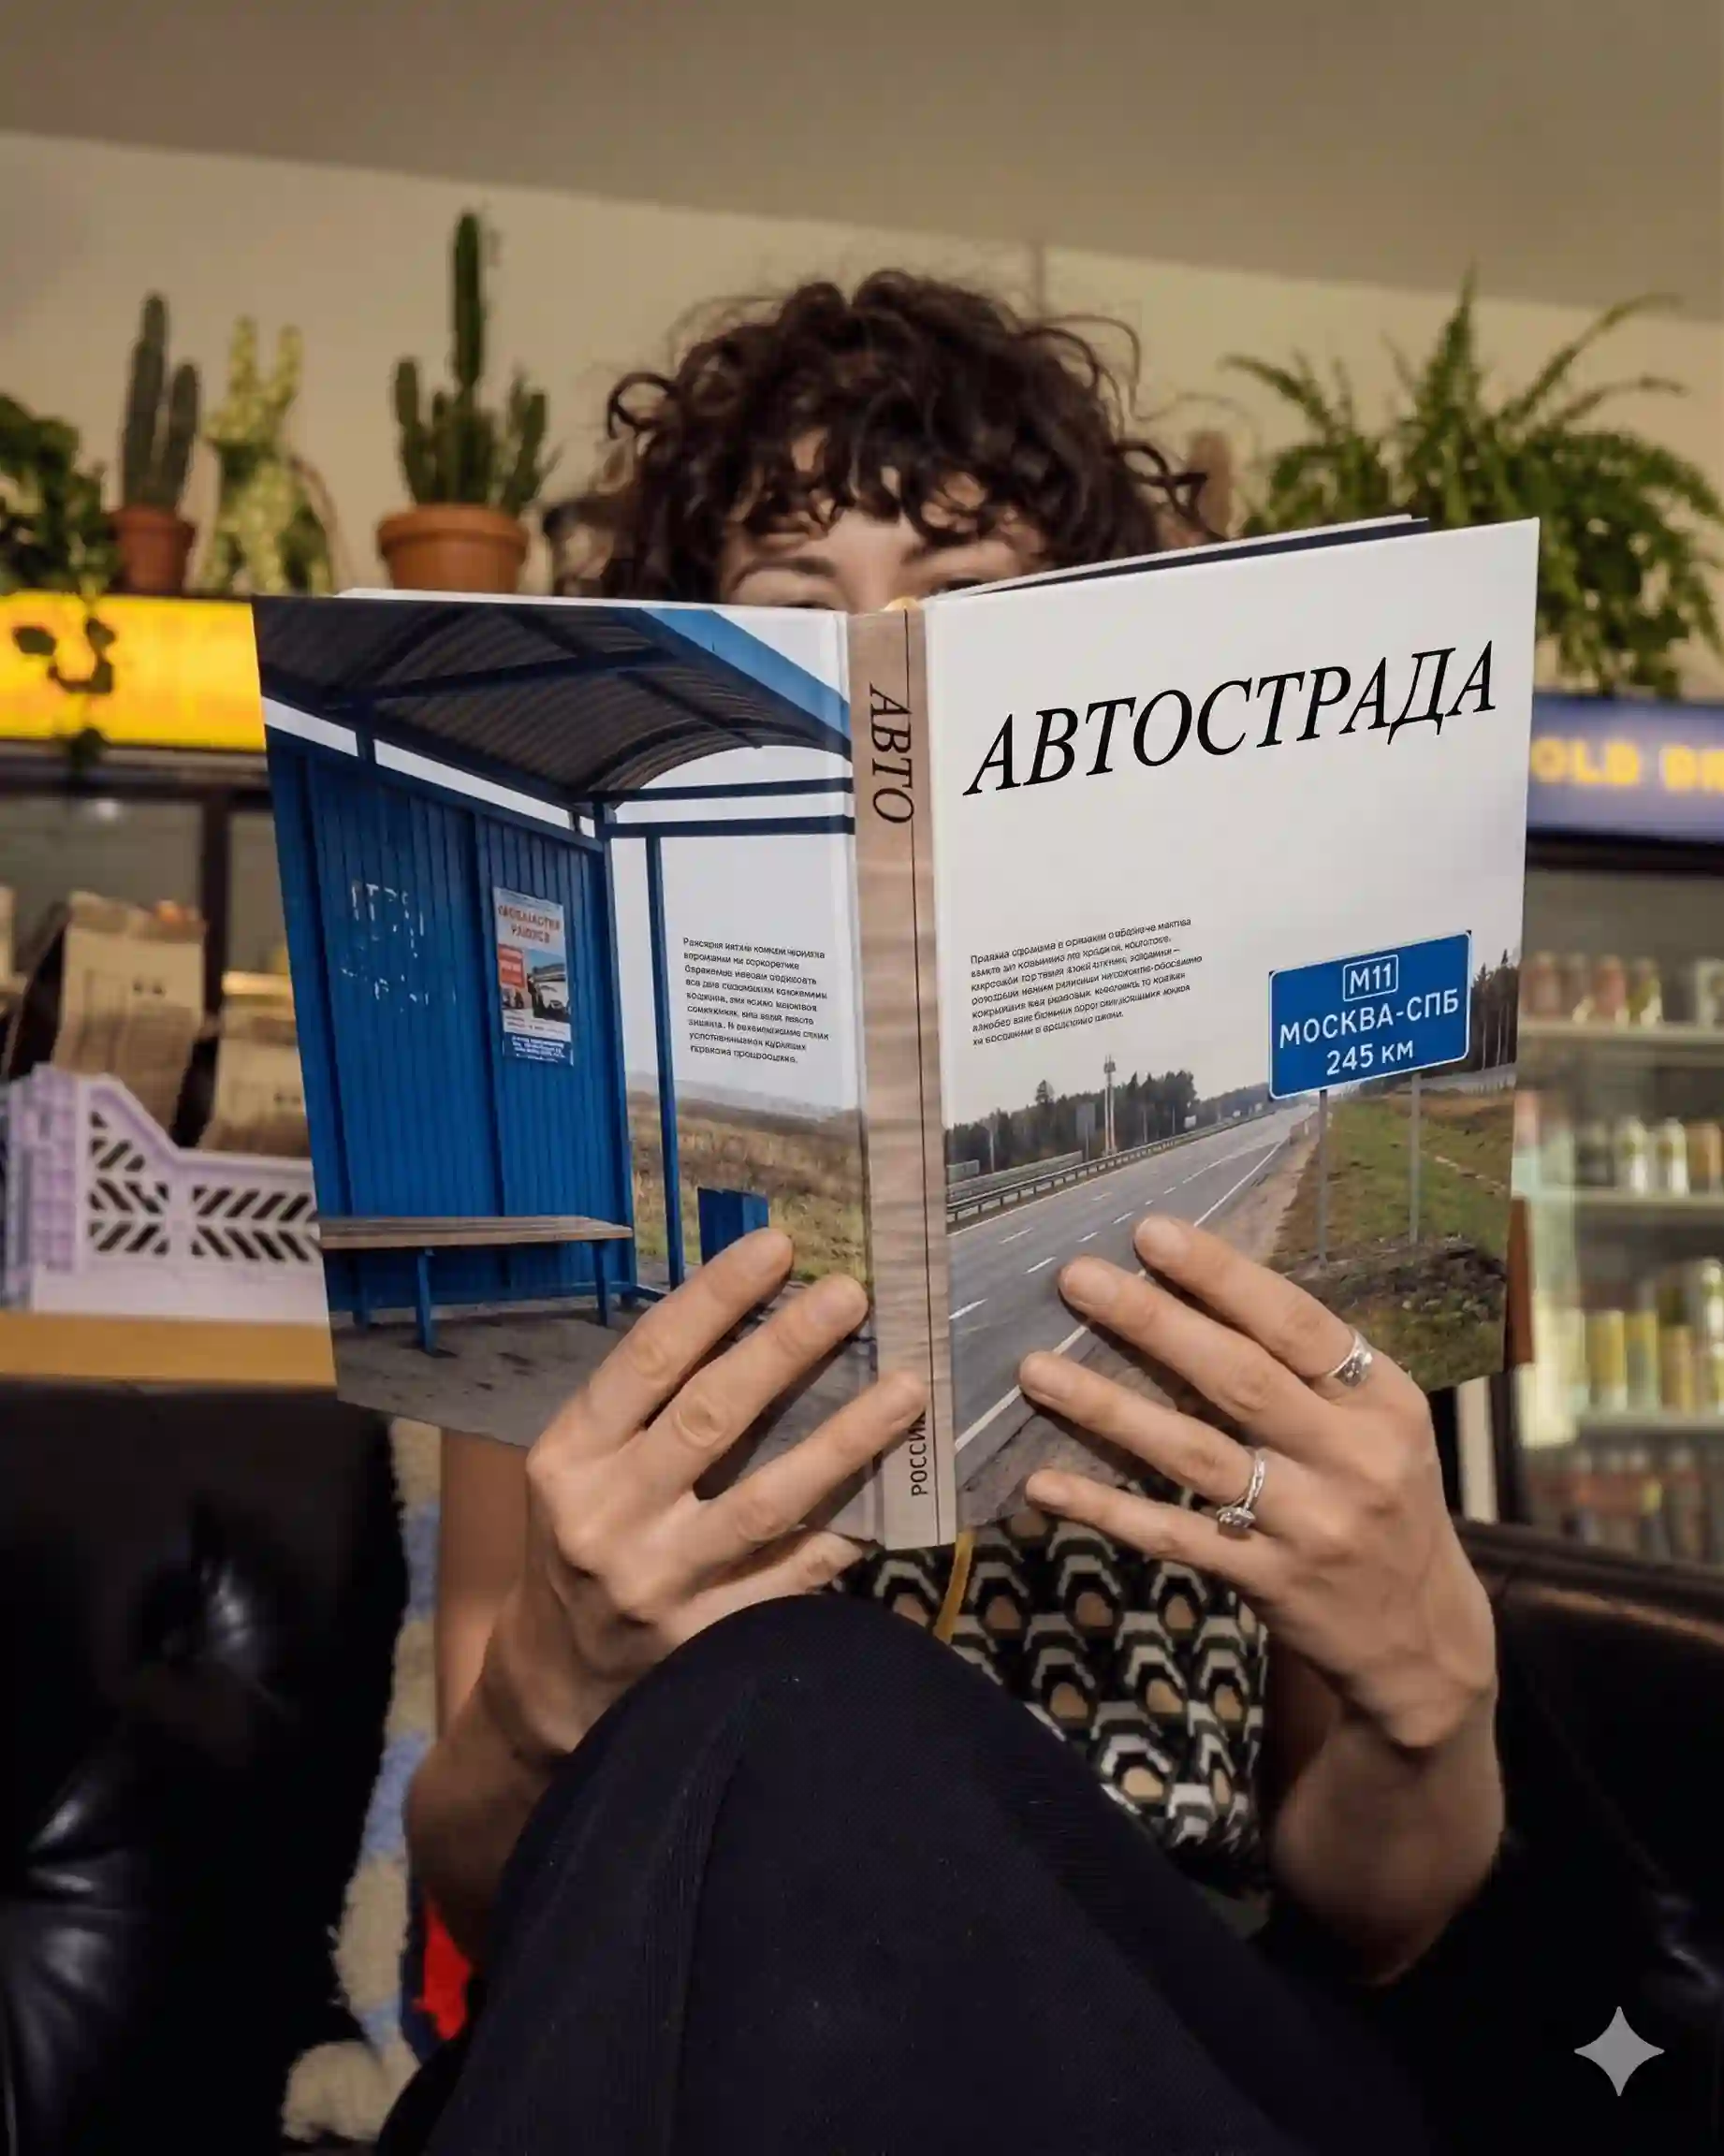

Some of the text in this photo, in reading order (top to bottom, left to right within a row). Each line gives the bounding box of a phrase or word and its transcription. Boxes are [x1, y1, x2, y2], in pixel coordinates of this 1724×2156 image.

[963, 639, 1496, 795] АВТОСТРАДА
[869, 681, 914, 823] АВТО
[1350, 962, 1392, 995] М11
[1279, 988, 1459, 1049] МОСКВА-СПБ
[1326, 1042, 1373, 1076] 245
